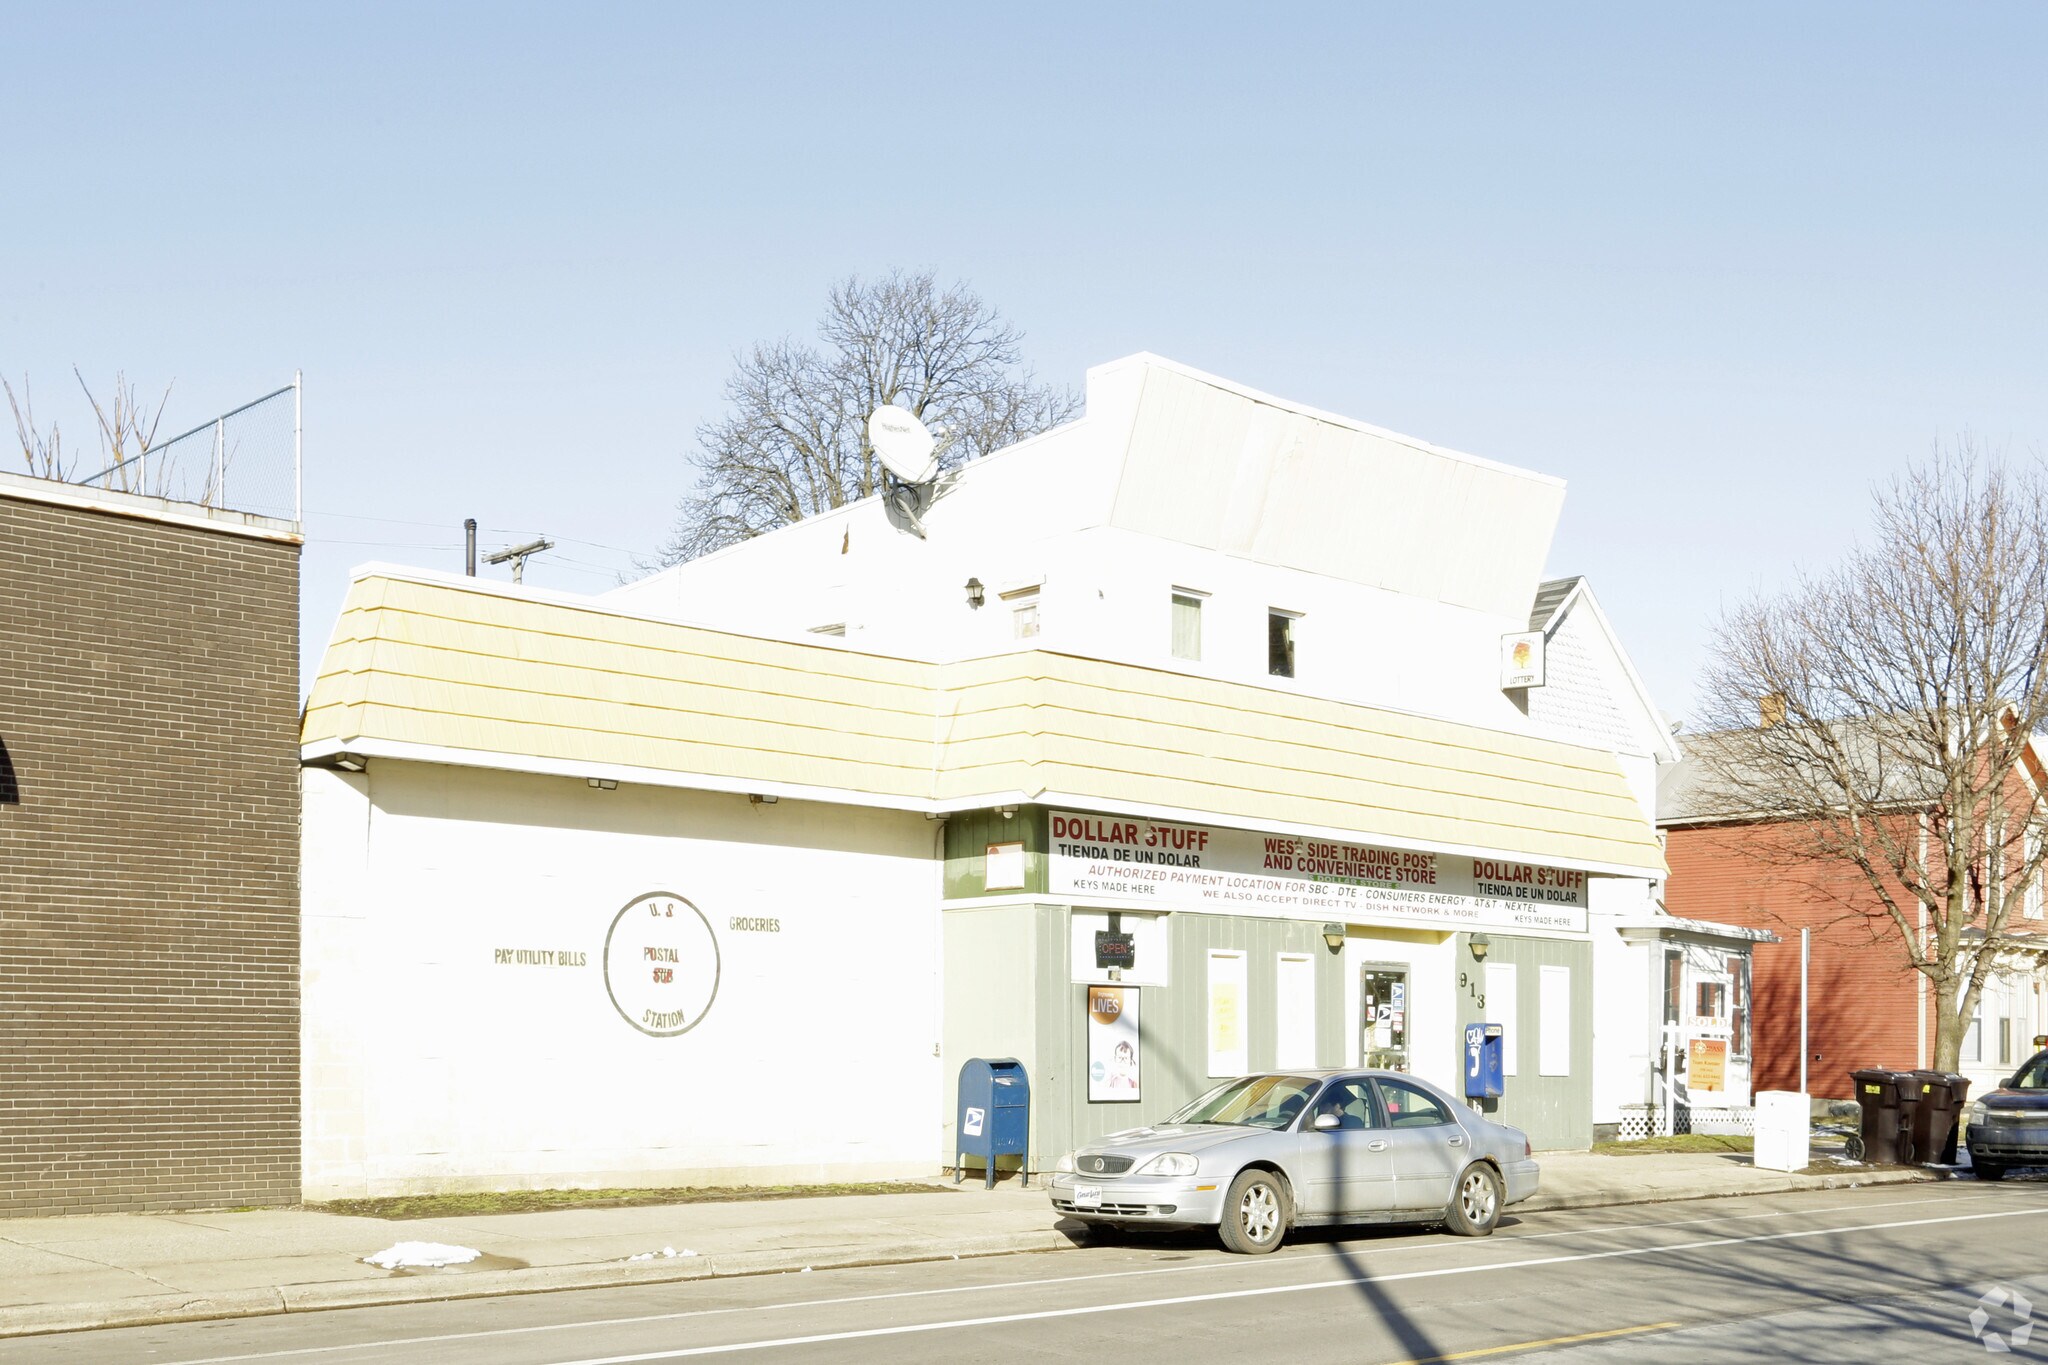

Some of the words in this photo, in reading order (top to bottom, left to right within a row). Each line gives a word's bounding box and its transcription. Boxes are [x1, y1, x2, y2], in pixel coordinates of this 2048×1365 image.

[1510, 675, 1534, 684] LOTTERY
[1053, 816, 1138, 845] DOLLAR
[1145, 826, 1209, 851] STUFF
[1059, 843, 1109, 860] TIENDA
[1114, 849, 1130, 862] DE
[1135, 850, 1153, 863] UN
[1158, 852, 1200, 868] DOLAR
[1307, 843, 1338, 860] SIDE
[1342, 846, 1399, 866] TRADING
[1263, 854, 1293, 870] AND
[1297, 857, 1392, 880] CONVENIENCE
[1396, 867, 1436, 884] STORE
[1473, 860, 1532, 883] DOLLAR
[1537, 867, 1583, 889] STUFF
[1074, 879, 1098, 890] KEYS
[1102, 881, 1128, 893] MADE
[1131, 884, 1156, 895] HERE
[1088, 865, 1167, 881] AUTHORIZED
[1170, 872, 1224, 886] PAYMENT
[1227, 876, 1282, 891] LOCATION
[1285, 882, 1306, 892] FOR
[1308, 884, 1329, 895] SBC
[1338, 886, 1357, 898] DTE
[1366, 889, 1425, 903] CONSUMERS
[1429, 894, 1466, 906] ENERGY
[1474, 898, 1497, 909] AT&T
[1505, 902, 1537, 913] NEXTEL
[1317, 875, 1357, 885] DOLLAR
[1360, 879, 1392, 888] STORE
[1478, 882, 1512, 897] TIENDA
[1516, 886, 1528, 898] DE
[1531, 888, 1544, 900] UN
[1547, 890, 1577, 903] DOLAR
[666, 903, 675, 918] S
[1203, 890, 1220, 898] WE
[1224, 892, 1253, 901] ALSO
[1257, 894, 1298, 904] ACCEPT
[1303, 898, 1340, 908] DIRECT
[1345, 900, 1357, 909] TV
[1366, 903, 1389, 911] DISH
[1393, 904, 1440, 915] NETWORK
[1453, 909, 1479, 918] MORE
[729, 916, 780, 933] GROCERIES
[1515, 915, 1532, 923] KEYS
[1534, 916, 1552, 925] MADE
[1554, 918, 1571, 926] HERE
[643, 946, 680, 963] POSTAL
[1102, 943, 1127, 954] OPEN
[494, 948, 514, 965] PAY
[516, 949, 554, 966] UTILITY
[558, 951, 587, 967] BILLS
[1092, 998, 1119, 1014] LIVES
[642, 1008, 685, 1029] STATION
[1689, 1017, 1726, 1026] SOLD
[1485, 1026, 1500, 1034] Phone
